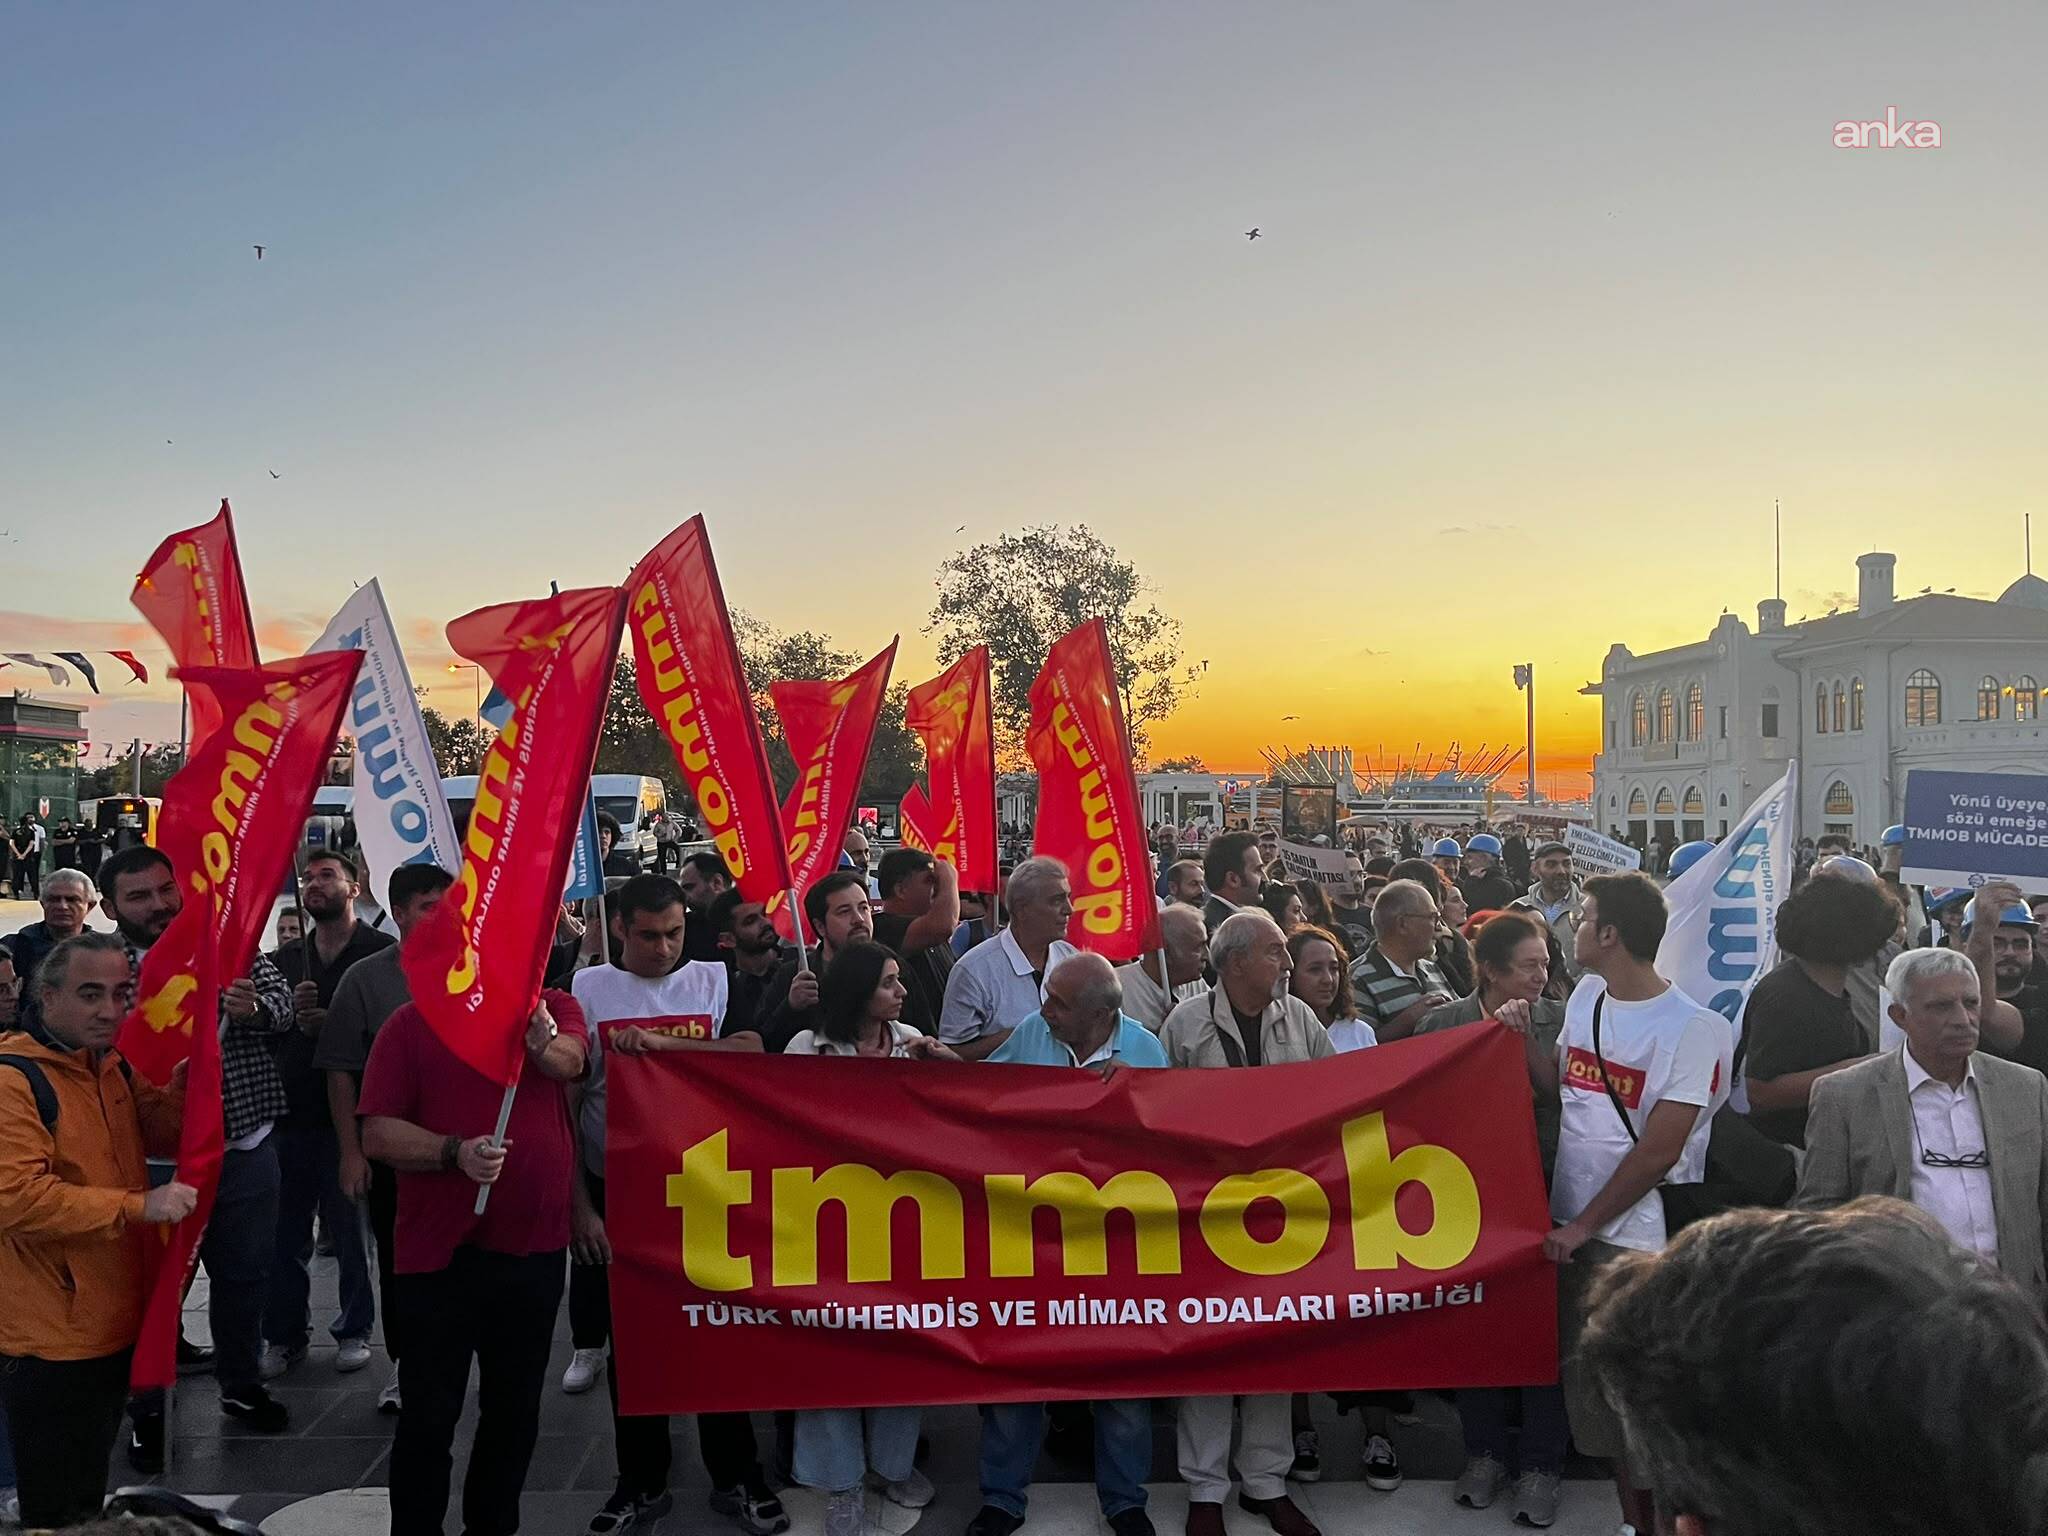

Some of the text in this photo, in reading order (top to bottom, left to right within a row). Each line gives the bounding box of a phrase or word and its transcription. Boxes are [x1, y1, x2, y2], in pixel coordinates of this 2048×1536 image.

[1949, 794, 1991, 808] Yönü
[1946, 812, 2048, 831] sözü emeğe
[1906, 826, 1970, 842] TMMOB
[666, 1111, 1482, 1292] tmmob
[682, 1281, 1483, 1330] TÜRK MÜHENDİS VE MİMAR ODALARI BİRLİĞİ
